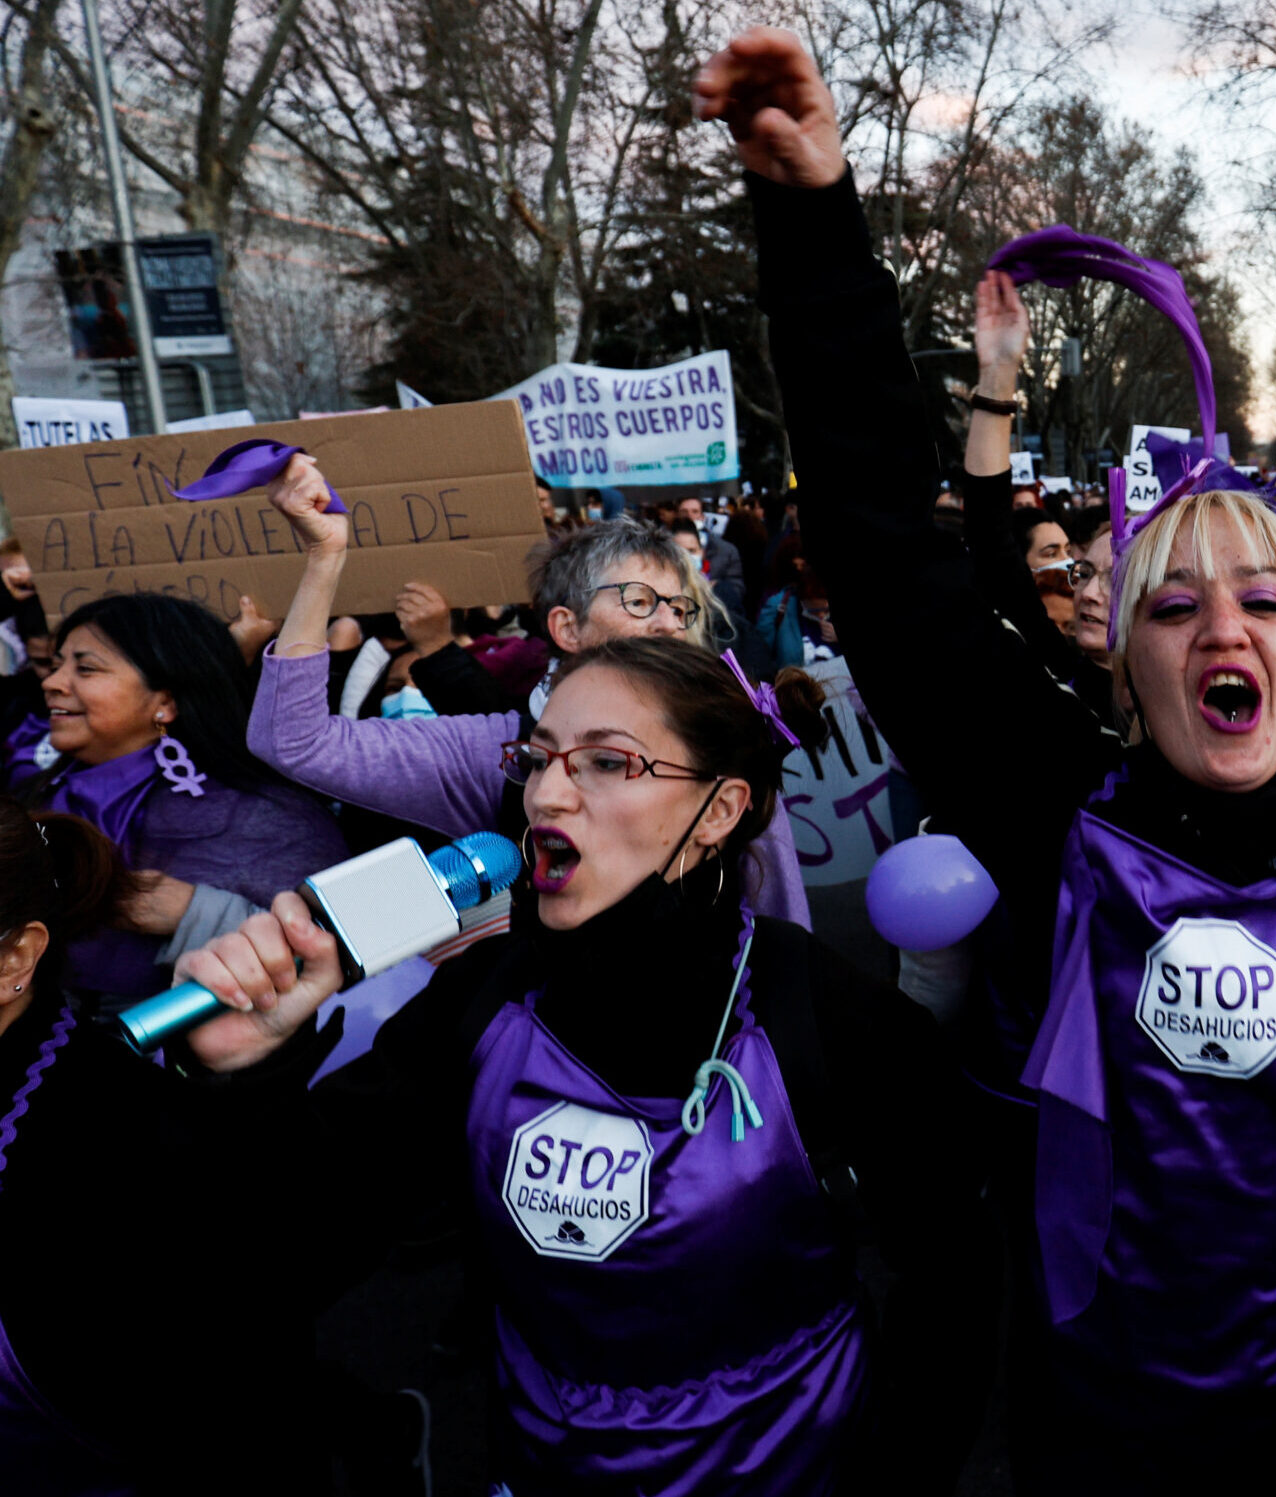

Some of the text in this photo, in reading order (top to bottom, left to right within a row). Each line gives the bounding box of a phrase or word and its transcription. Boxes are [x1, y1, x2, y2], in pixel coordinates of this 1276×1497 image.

[540, 377, 567, 408] NO
[574, 376, 600, 404] ES
[614, 402, 724, 438] CUERPOS
[42, 516, 69, 571] A
[89, 510, 135, 568] LA
[401, 487, 470, 543] DE
[1157, 964, 1275, 1011] STOP
[525, 1133, 642, 1193] STOP
[517, 1185, 632, 1222] DESAHUCIOS
